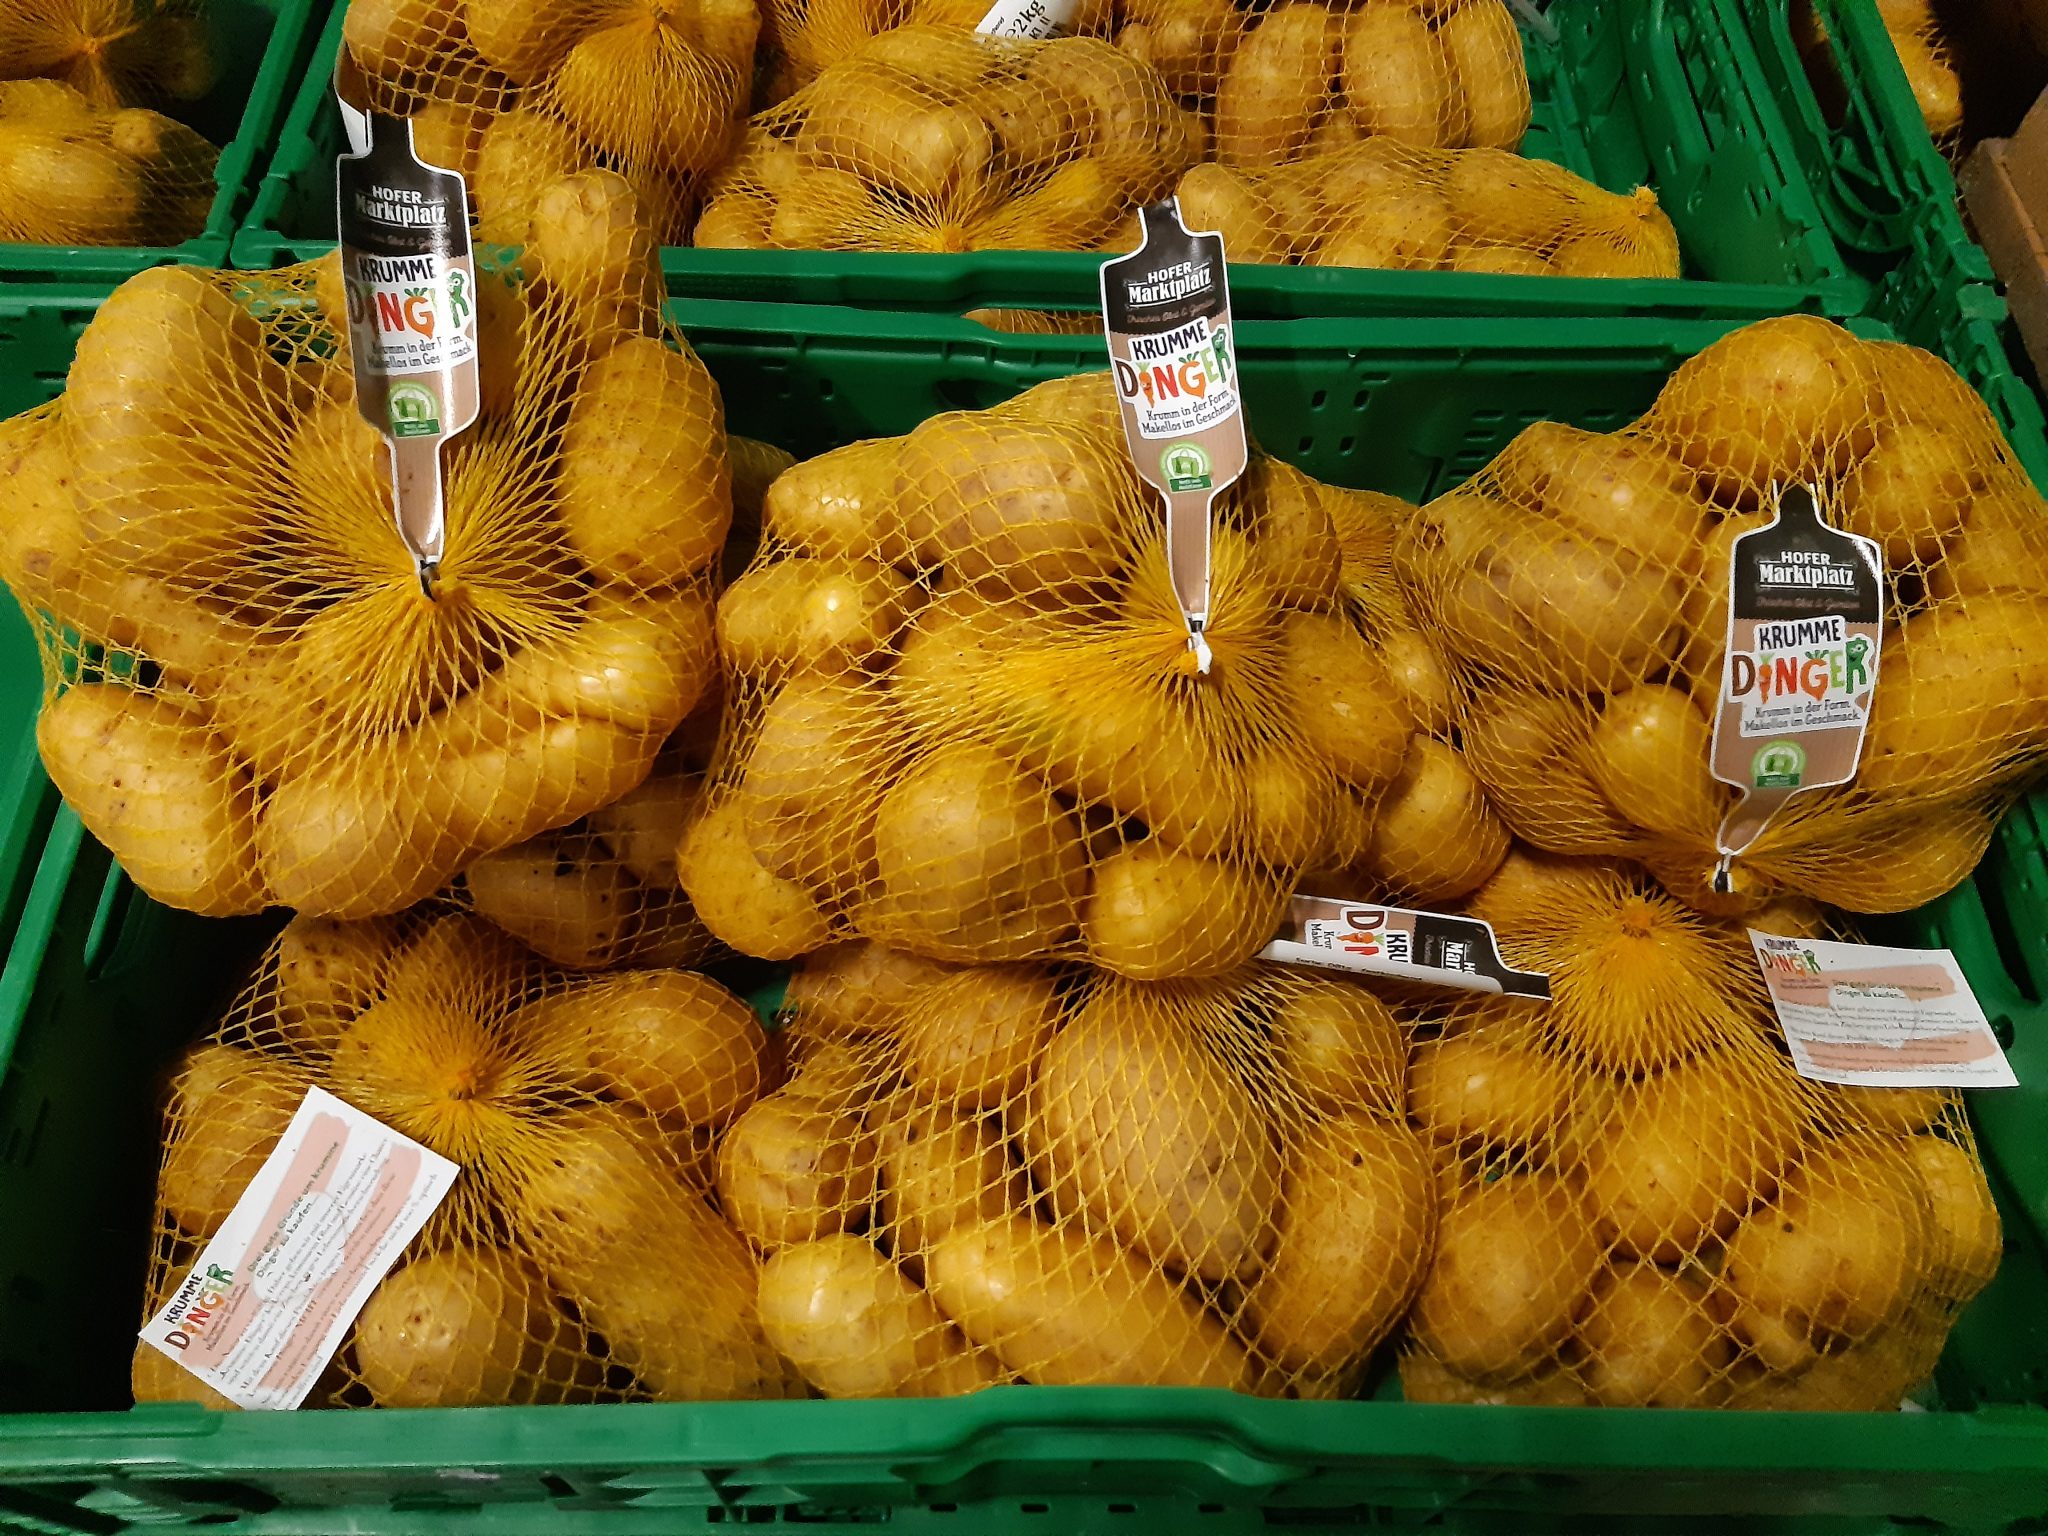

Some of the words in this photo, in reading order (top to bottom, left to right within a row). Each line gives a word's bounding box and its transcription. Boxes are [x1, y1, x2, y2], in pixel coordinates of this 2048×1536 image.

[356, 193, 446, 227] Marktplatz
[372, 185, 423, 204] HOFER
[358, 257, 437, 283] KRUMME
[1128, 267, 1212, 302] Marktplatz
[1147, 261, 1192, 284] HOFER
[348, 272, 469, 340] DINGR
[1132, 321, 1207, 360] KRUMME
[1115, 328, 1231, 408] DINGER
[1142, 421, 1182, 434] Makellos
[1183, 419, 1195, 428] im
[1147, 409, 1181, 421] Krumm
[1181, 406, 1191, 416] in
[1192, 401, 1207, 414] der
[1781, 551, 1831, 566] HOFER
[1759, 564, 1854, 588] Marktplatz
[1759, 619, 1842, 650] KRUMME
[1732, 637, 1869, 704] DINGER
[1759, 947, 1822, 977] DINGER
[256, 1247, 281, 1279] Dinger
[164, 1273, 203, 1325] KRUMME
[164, 1263, 234, 1350] DINGER
